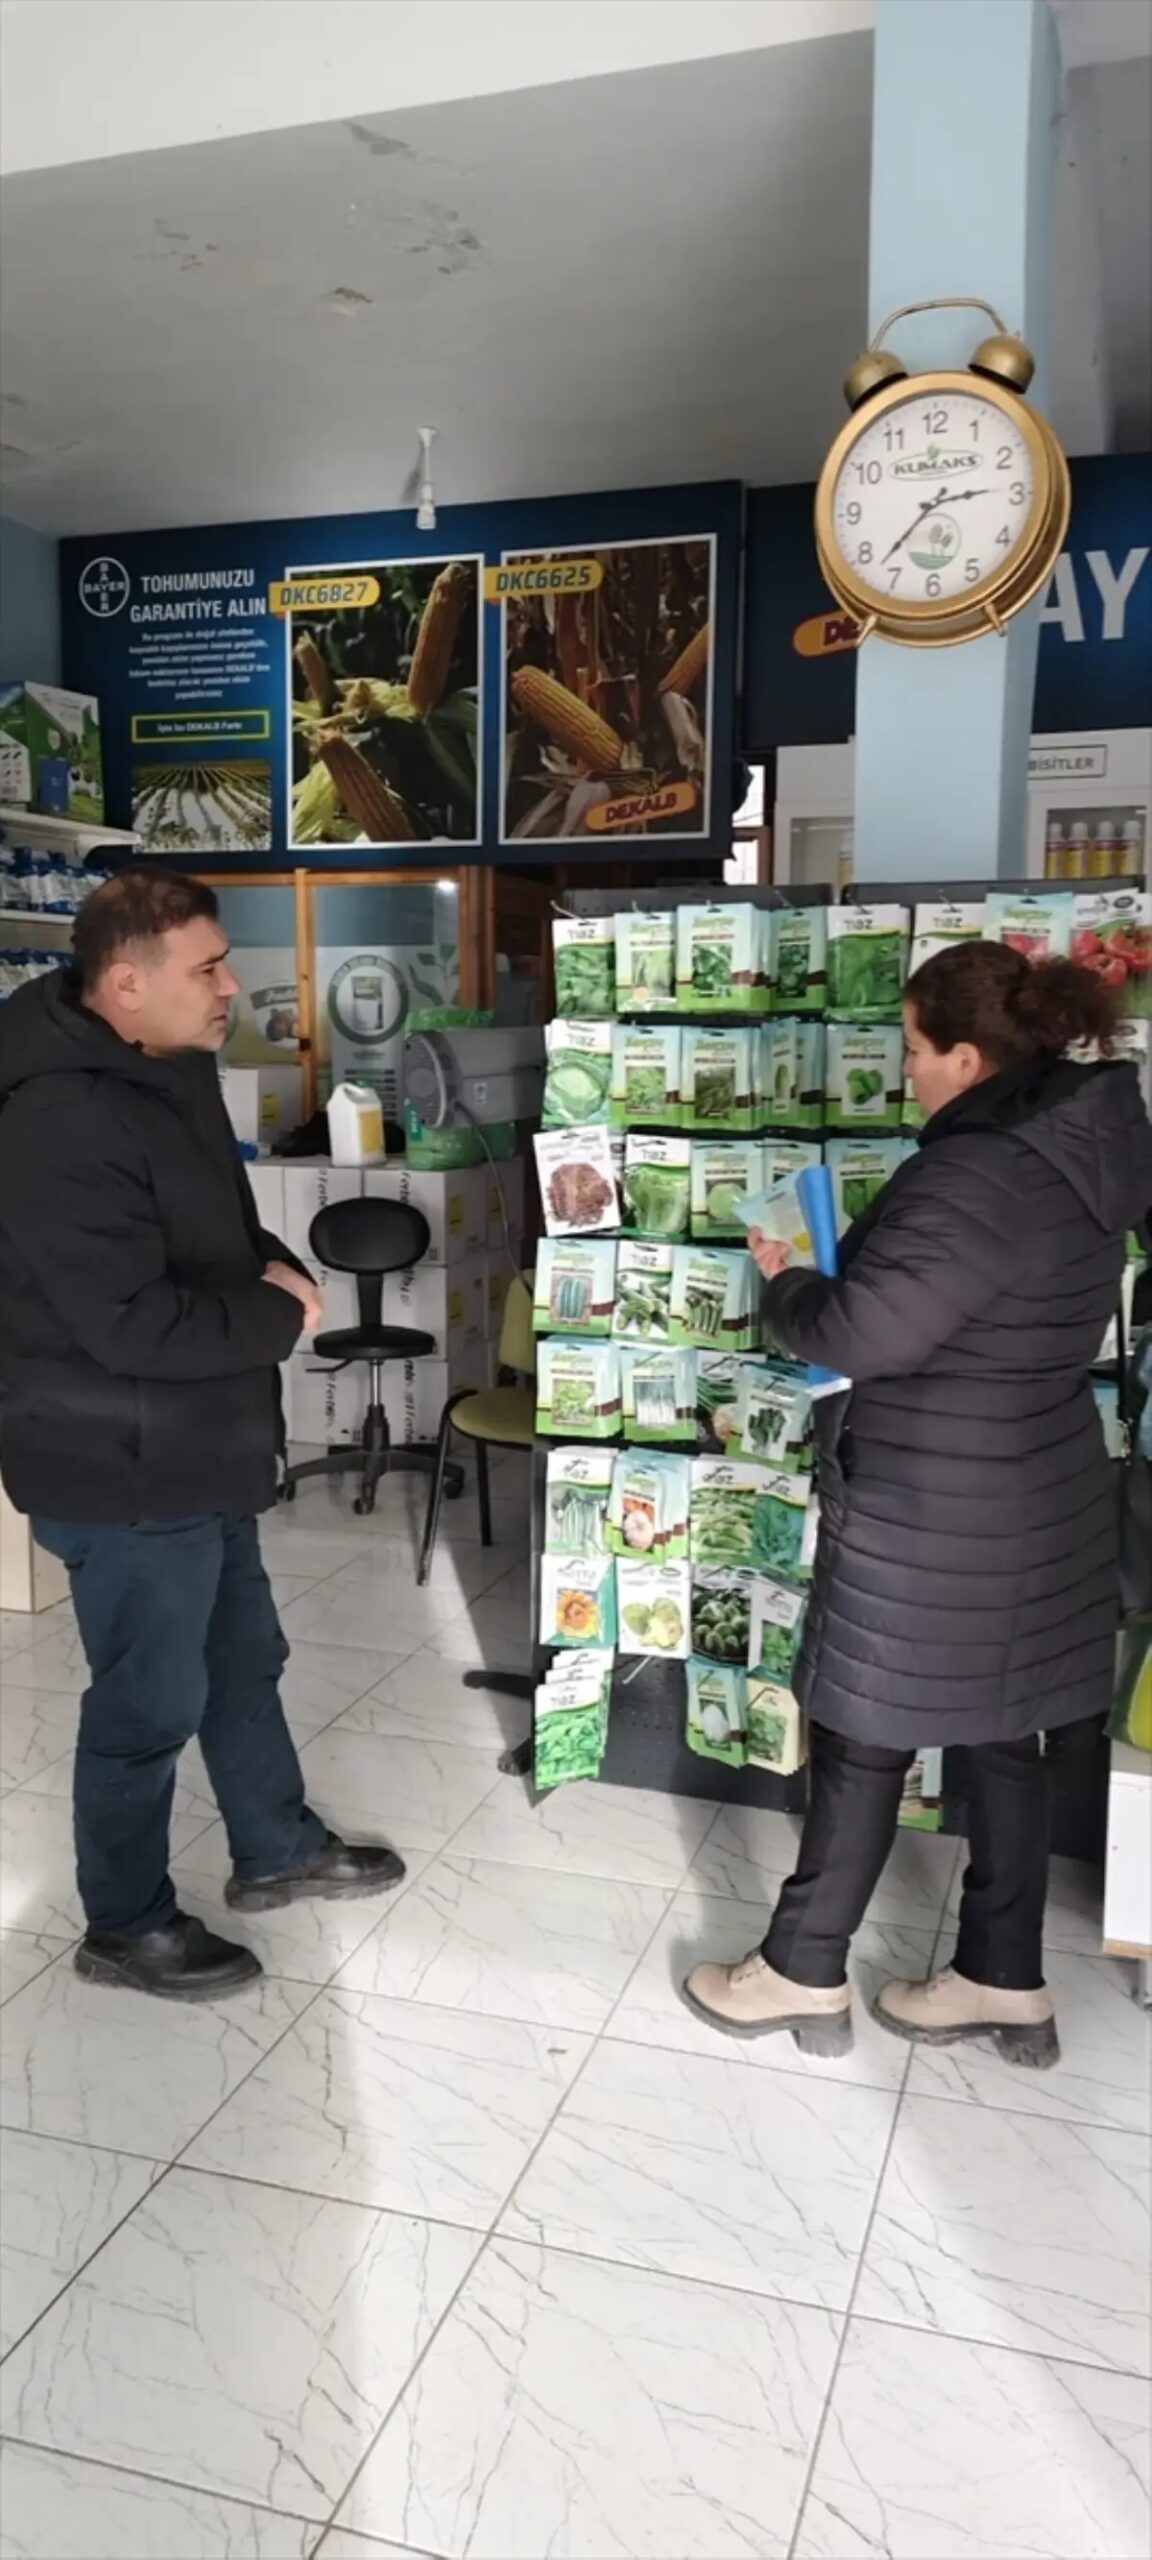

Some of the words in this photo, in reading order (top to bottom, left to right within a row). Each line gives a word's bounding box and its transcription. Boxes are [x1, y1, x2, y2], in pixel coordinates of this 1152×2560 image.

[922, 411, 949, 434] 12
[969, 420, 980, 442] 1
[884, 428, 905, 450] 11
[996, 446, 1012, 470] 2
[856, 461, 882, 485] 10
[1009, 481, 1025, 505] 3
[846, 502, 862, 525] 9
[995, 525, 1010, 548] 4
[858, 541, 873, 565] 8
[140, 569, 255, 594] TOHUMUNUZU
[496, 566, 592, 591] DKC6625
[887, 567, 903, 590] 7
[965, 558, 980, 582] 5
[83, 581, 126, 593] BAYER
[280, 581, 369, 605] DKC6827
[925, 573, 941, 597] 6
[130, 599, 222, 623] GARANTİYE
[227, 598, 266, 617] ALIN
[604, 792, 677, 823] DEKALB
